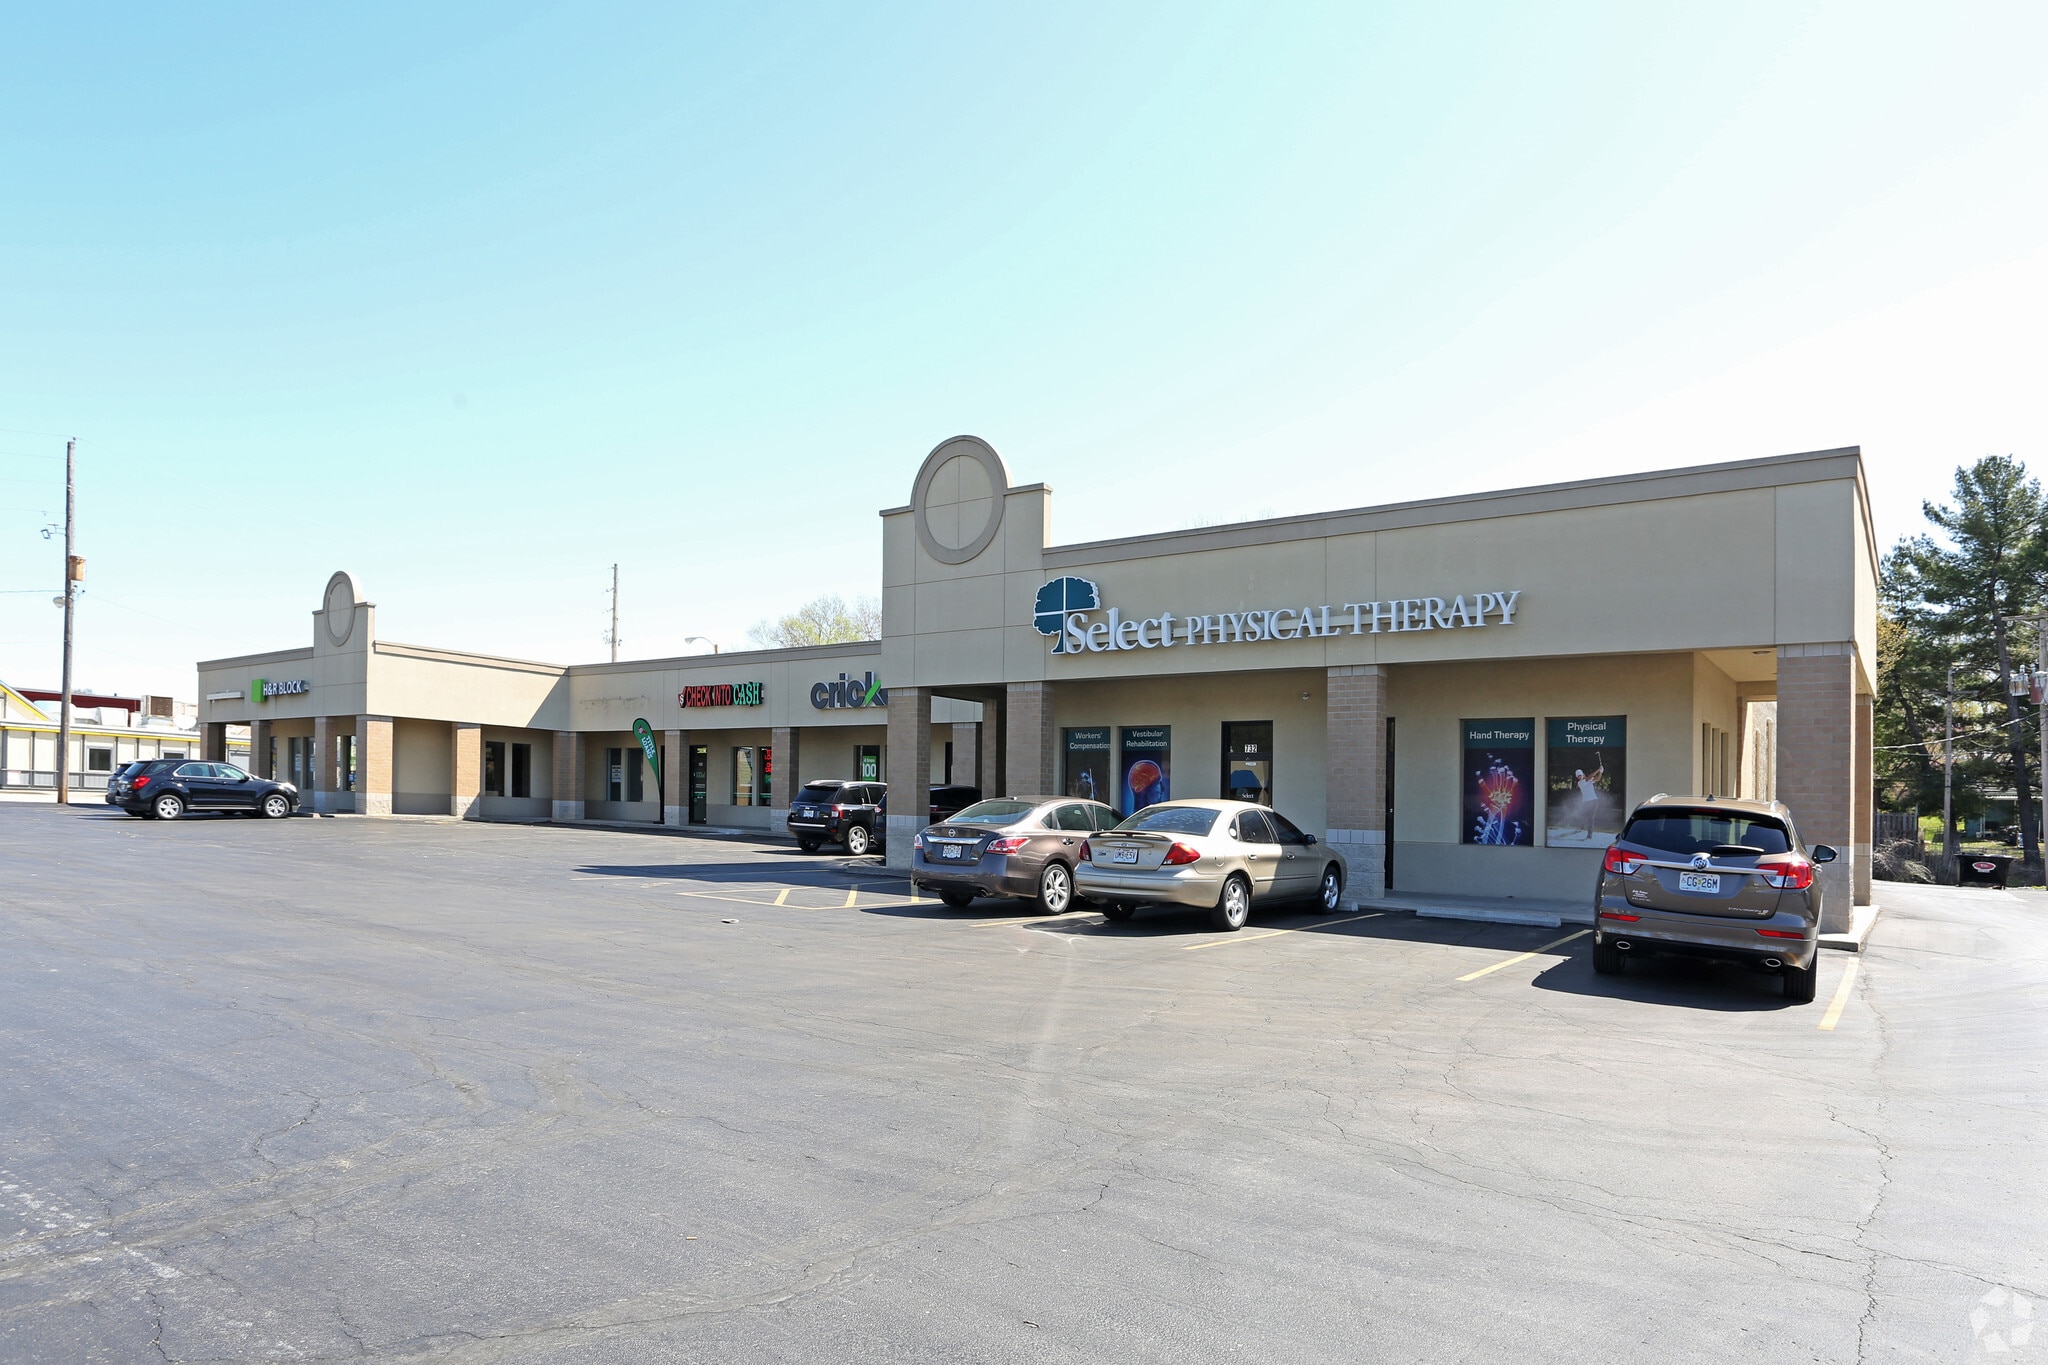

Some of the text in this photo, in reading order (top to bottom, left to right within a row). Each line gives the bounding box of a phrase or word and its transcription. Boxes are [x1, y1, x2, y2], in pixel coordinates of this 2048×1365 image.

[1066, 590, 1522, 654] Select PHYSICAL THERAPY
[263, 680, 302, 696] H&R BLOCK
[686, 685, 711, 707] CHECK
[713, 684, 732, 706] INTO
[1567, 722, 1607, 732] Physical
[1132, 730, 1164, 738] Vestibular
[1469, 730, 1529, 740] Hand Therapy
[1566, 734, 1605, 744] Therapy
[641, 736, 653, 759] LOANS
[1126, 740, 1168, 748] Rehabilitation
[1244, 743, 1258, 753] 732
[1686, 876, 1718, 889] CG 26M
